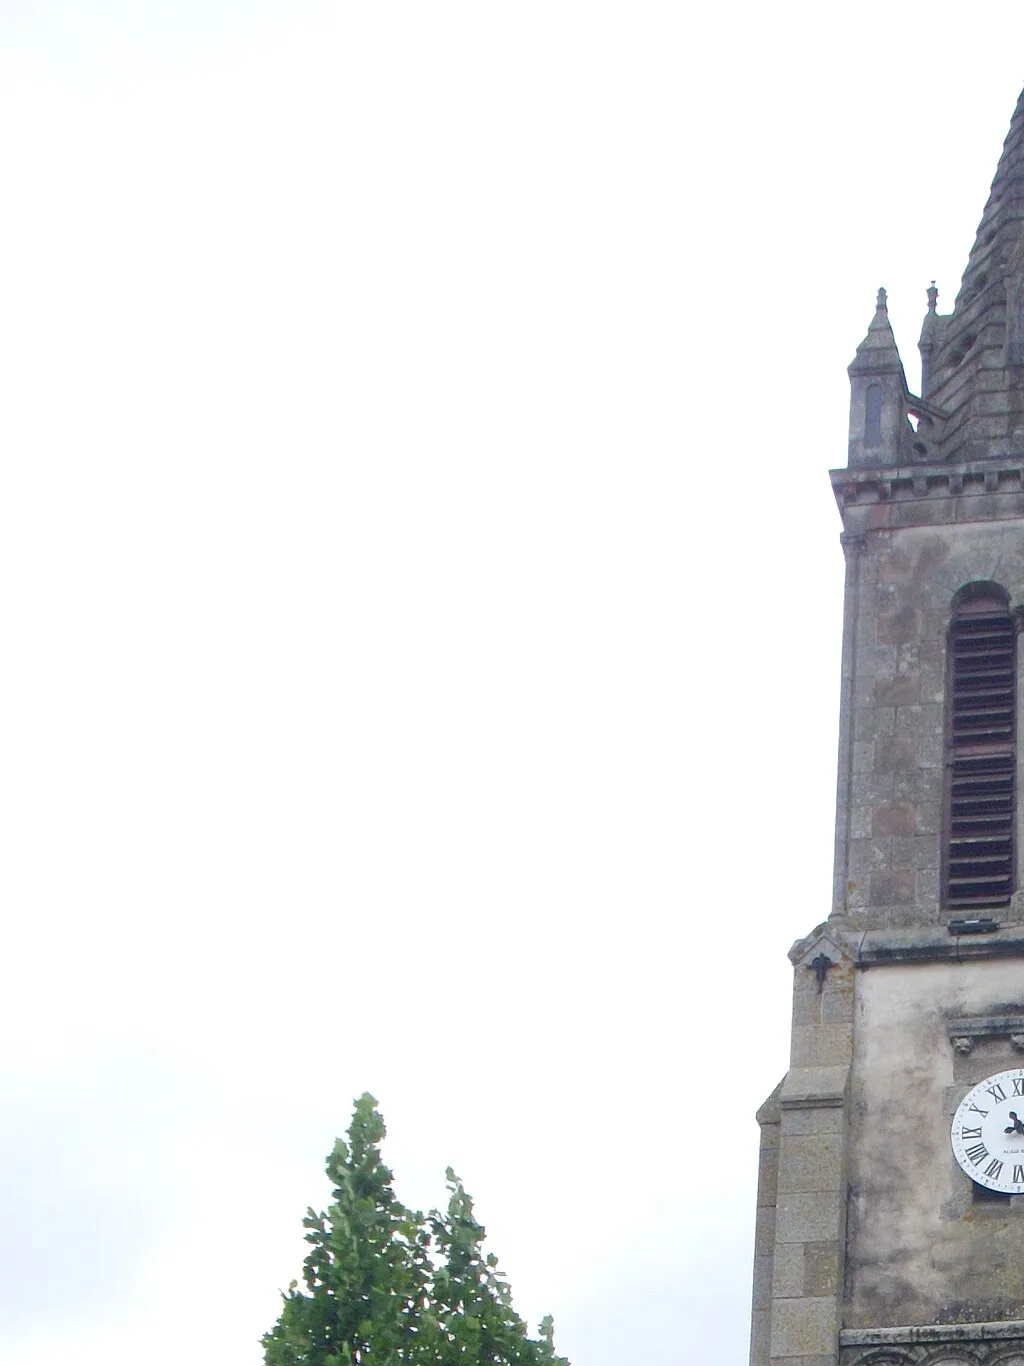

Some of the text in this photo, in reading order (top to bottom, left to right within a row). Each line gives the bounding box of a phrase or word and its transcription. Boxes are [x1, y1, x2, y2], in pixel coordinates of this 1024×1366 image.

[986, 1083, 1007, 1104] XI
[968, 1103, 989, 1118] X
[962, 1126, 982, 1140] IX
[965, 1142, 989, 1166] VIII
[984, 1158, 1004, 1180] VII
